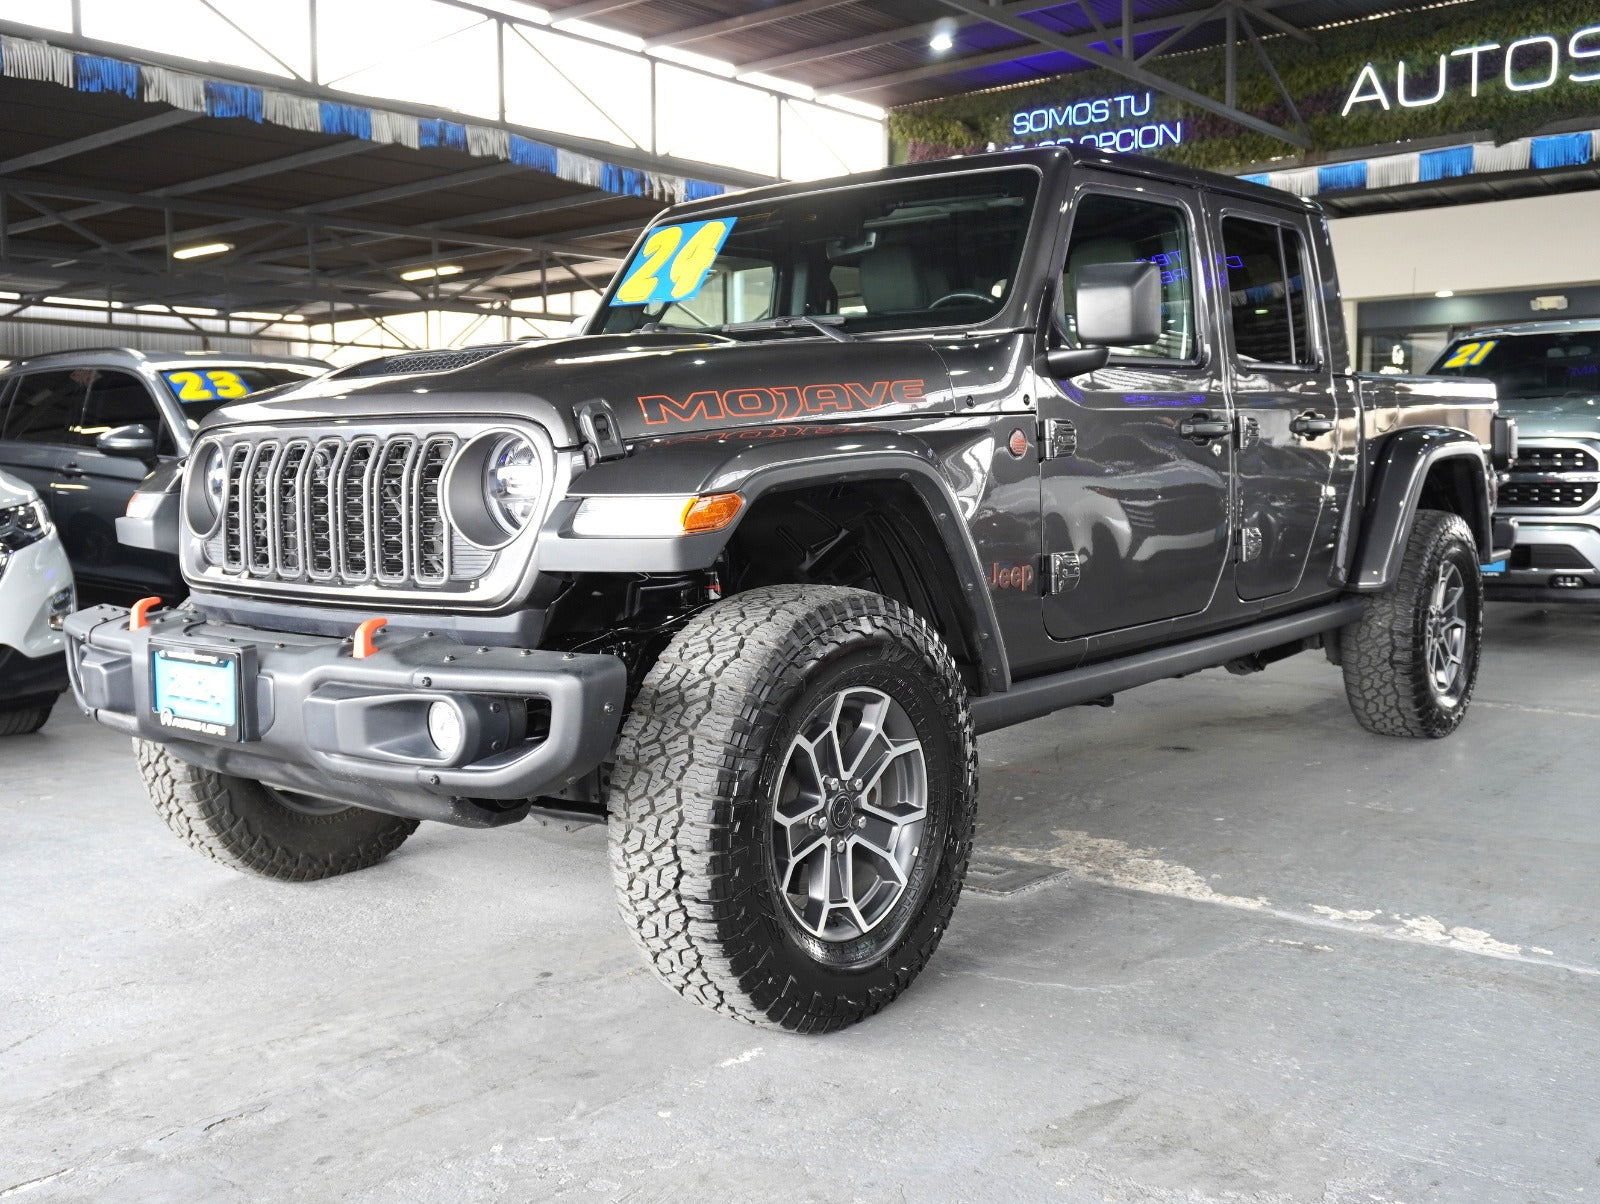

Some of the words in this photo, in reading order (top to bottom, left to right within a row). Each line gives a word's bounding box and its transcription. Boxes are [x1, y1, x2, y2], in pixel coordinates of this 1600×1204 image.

[1342, 27, 1600, 116] AUTOS
[1013, 99, 1110, 135] SOMOS
[1113, 93, 1150, 118] TU
[616, 220, 727, 303] 24
[1443, 340, 1496, 369] 21
[168, 370, 248, 401] 23
[636, 379, 928, 425] MOJAVE
[986, 562, 1034, 592] Jeep
